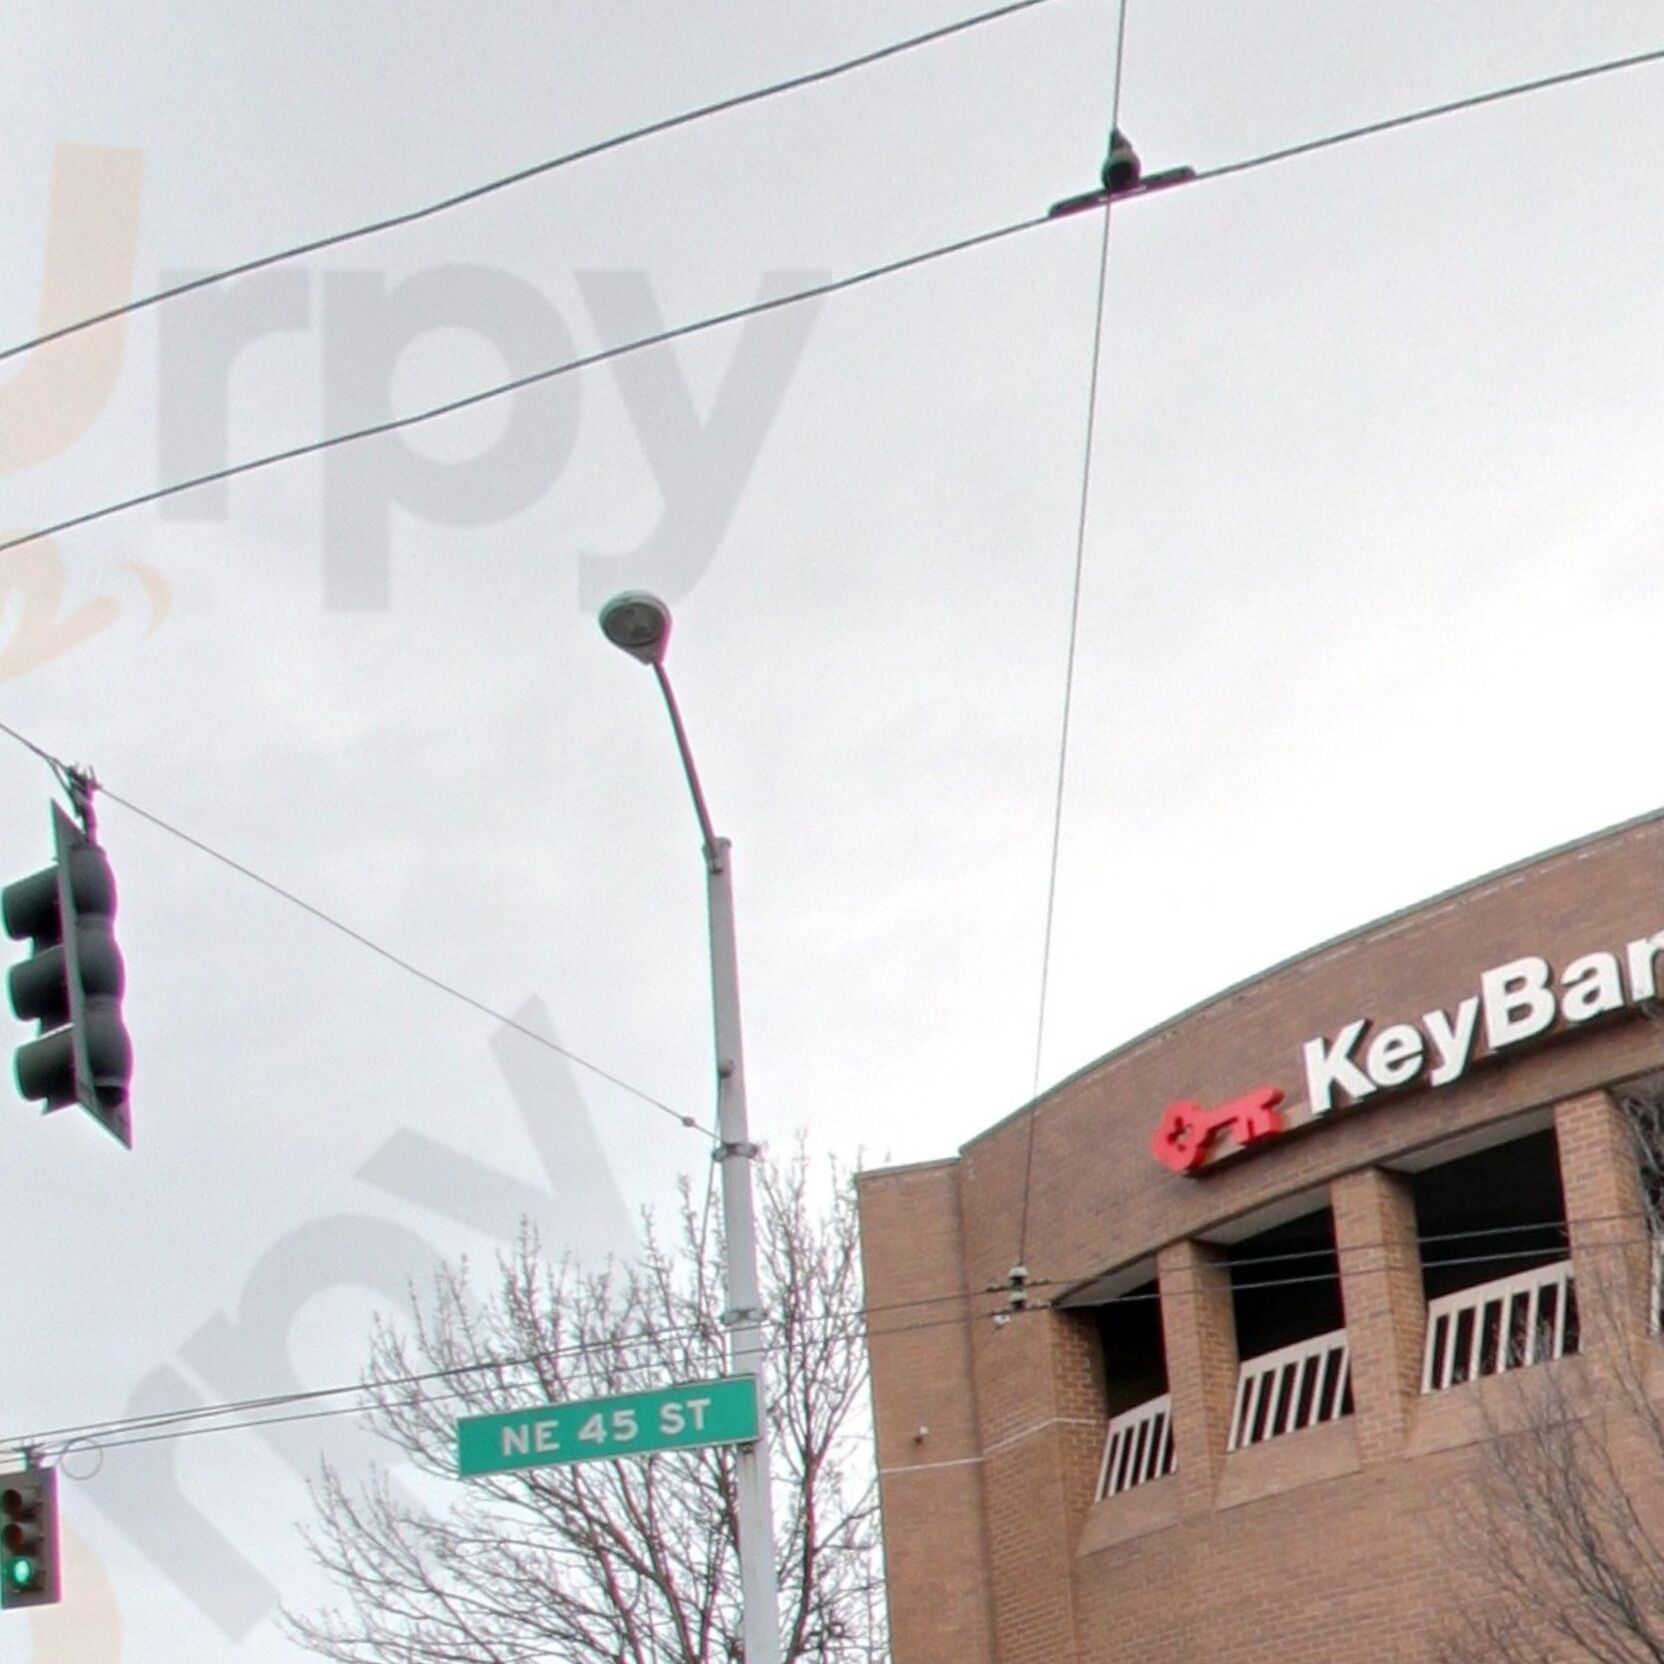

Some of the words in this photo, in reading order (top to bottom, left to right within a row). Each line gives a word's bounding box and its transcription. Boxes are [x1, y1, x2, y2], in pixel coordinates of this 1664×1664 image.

[500, 1420, 561, 1457] NE
[578, 1408, 639, 1445] 45
[659, 1398, 712, 1435] ST
